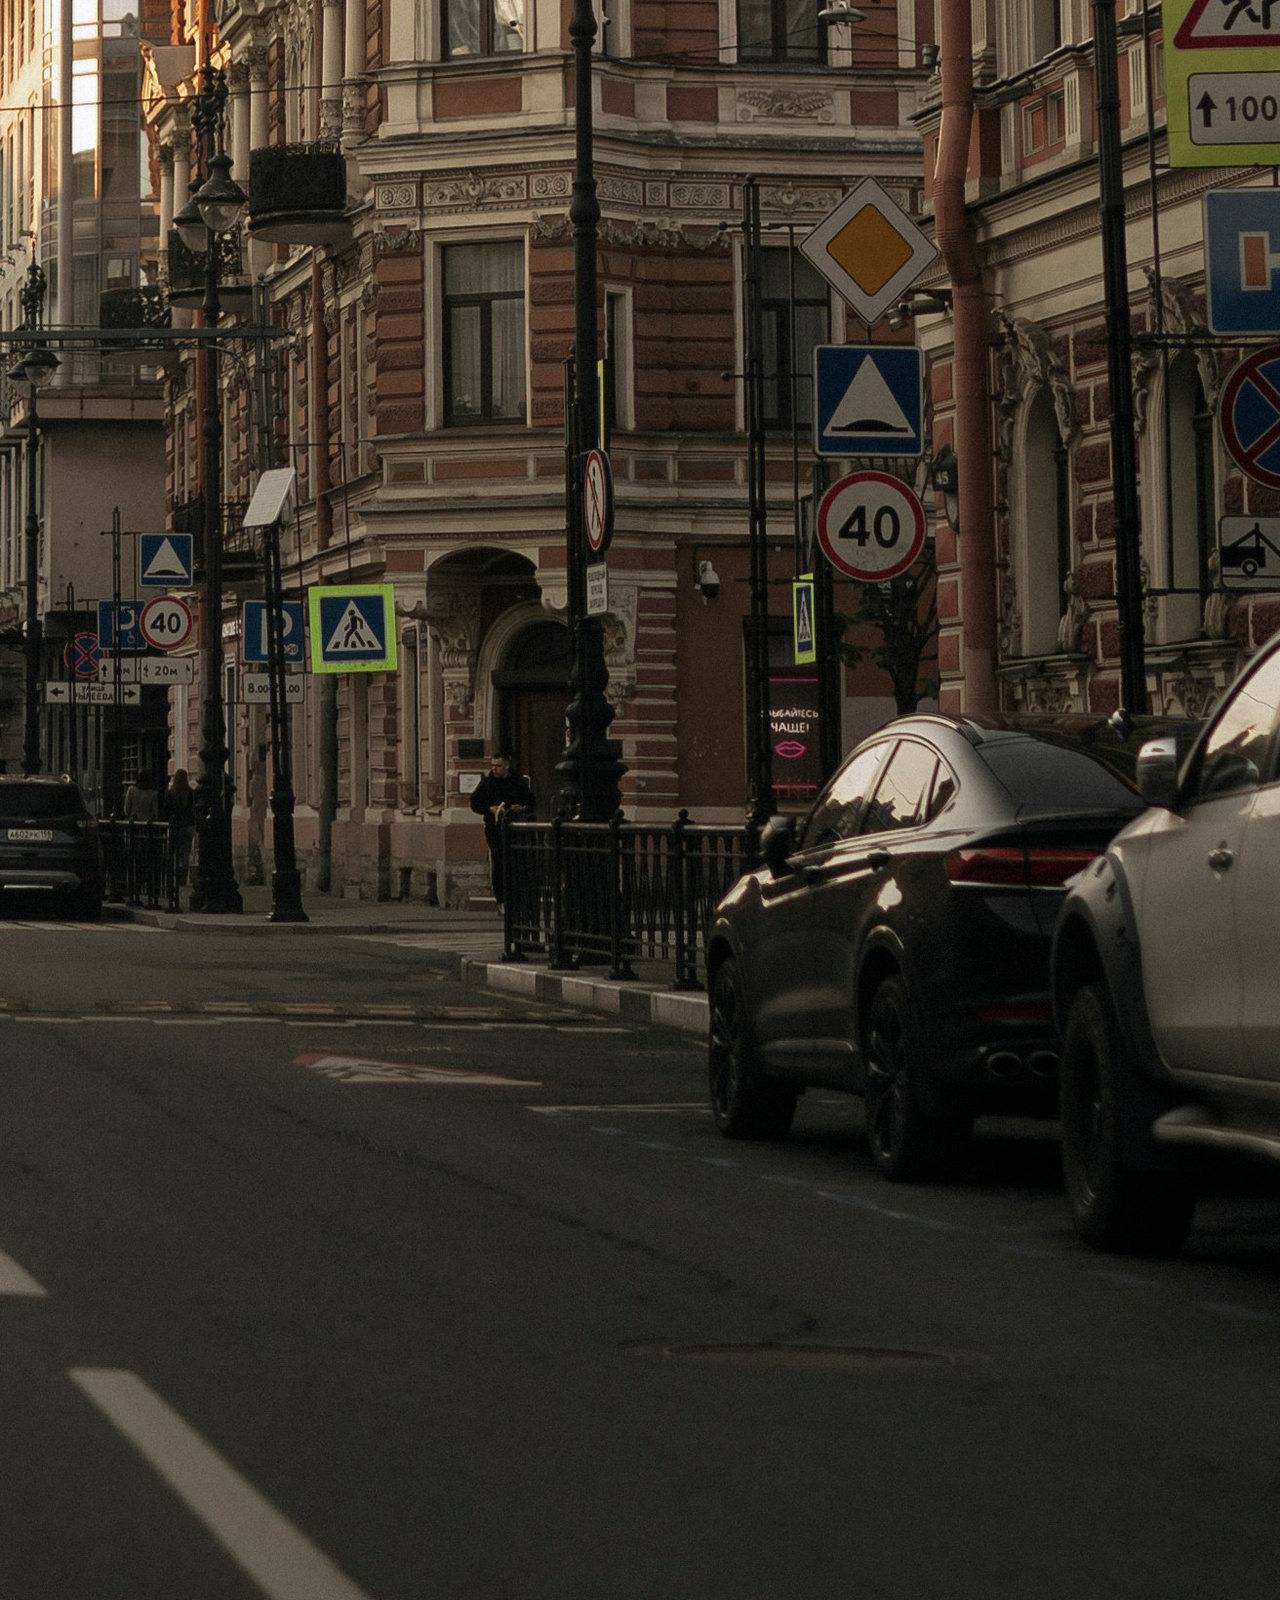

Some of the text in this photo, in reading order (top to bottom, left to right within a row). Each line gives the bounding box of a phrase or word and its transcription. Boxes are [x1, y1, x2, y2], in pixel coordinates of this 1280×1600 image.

[1225, 95, 1278, 122] 100
[838, 505, 900, 549] 40
[150, 612, 181, 634] 40
[770, 722, 810, 733] ЧАЩЕ!
